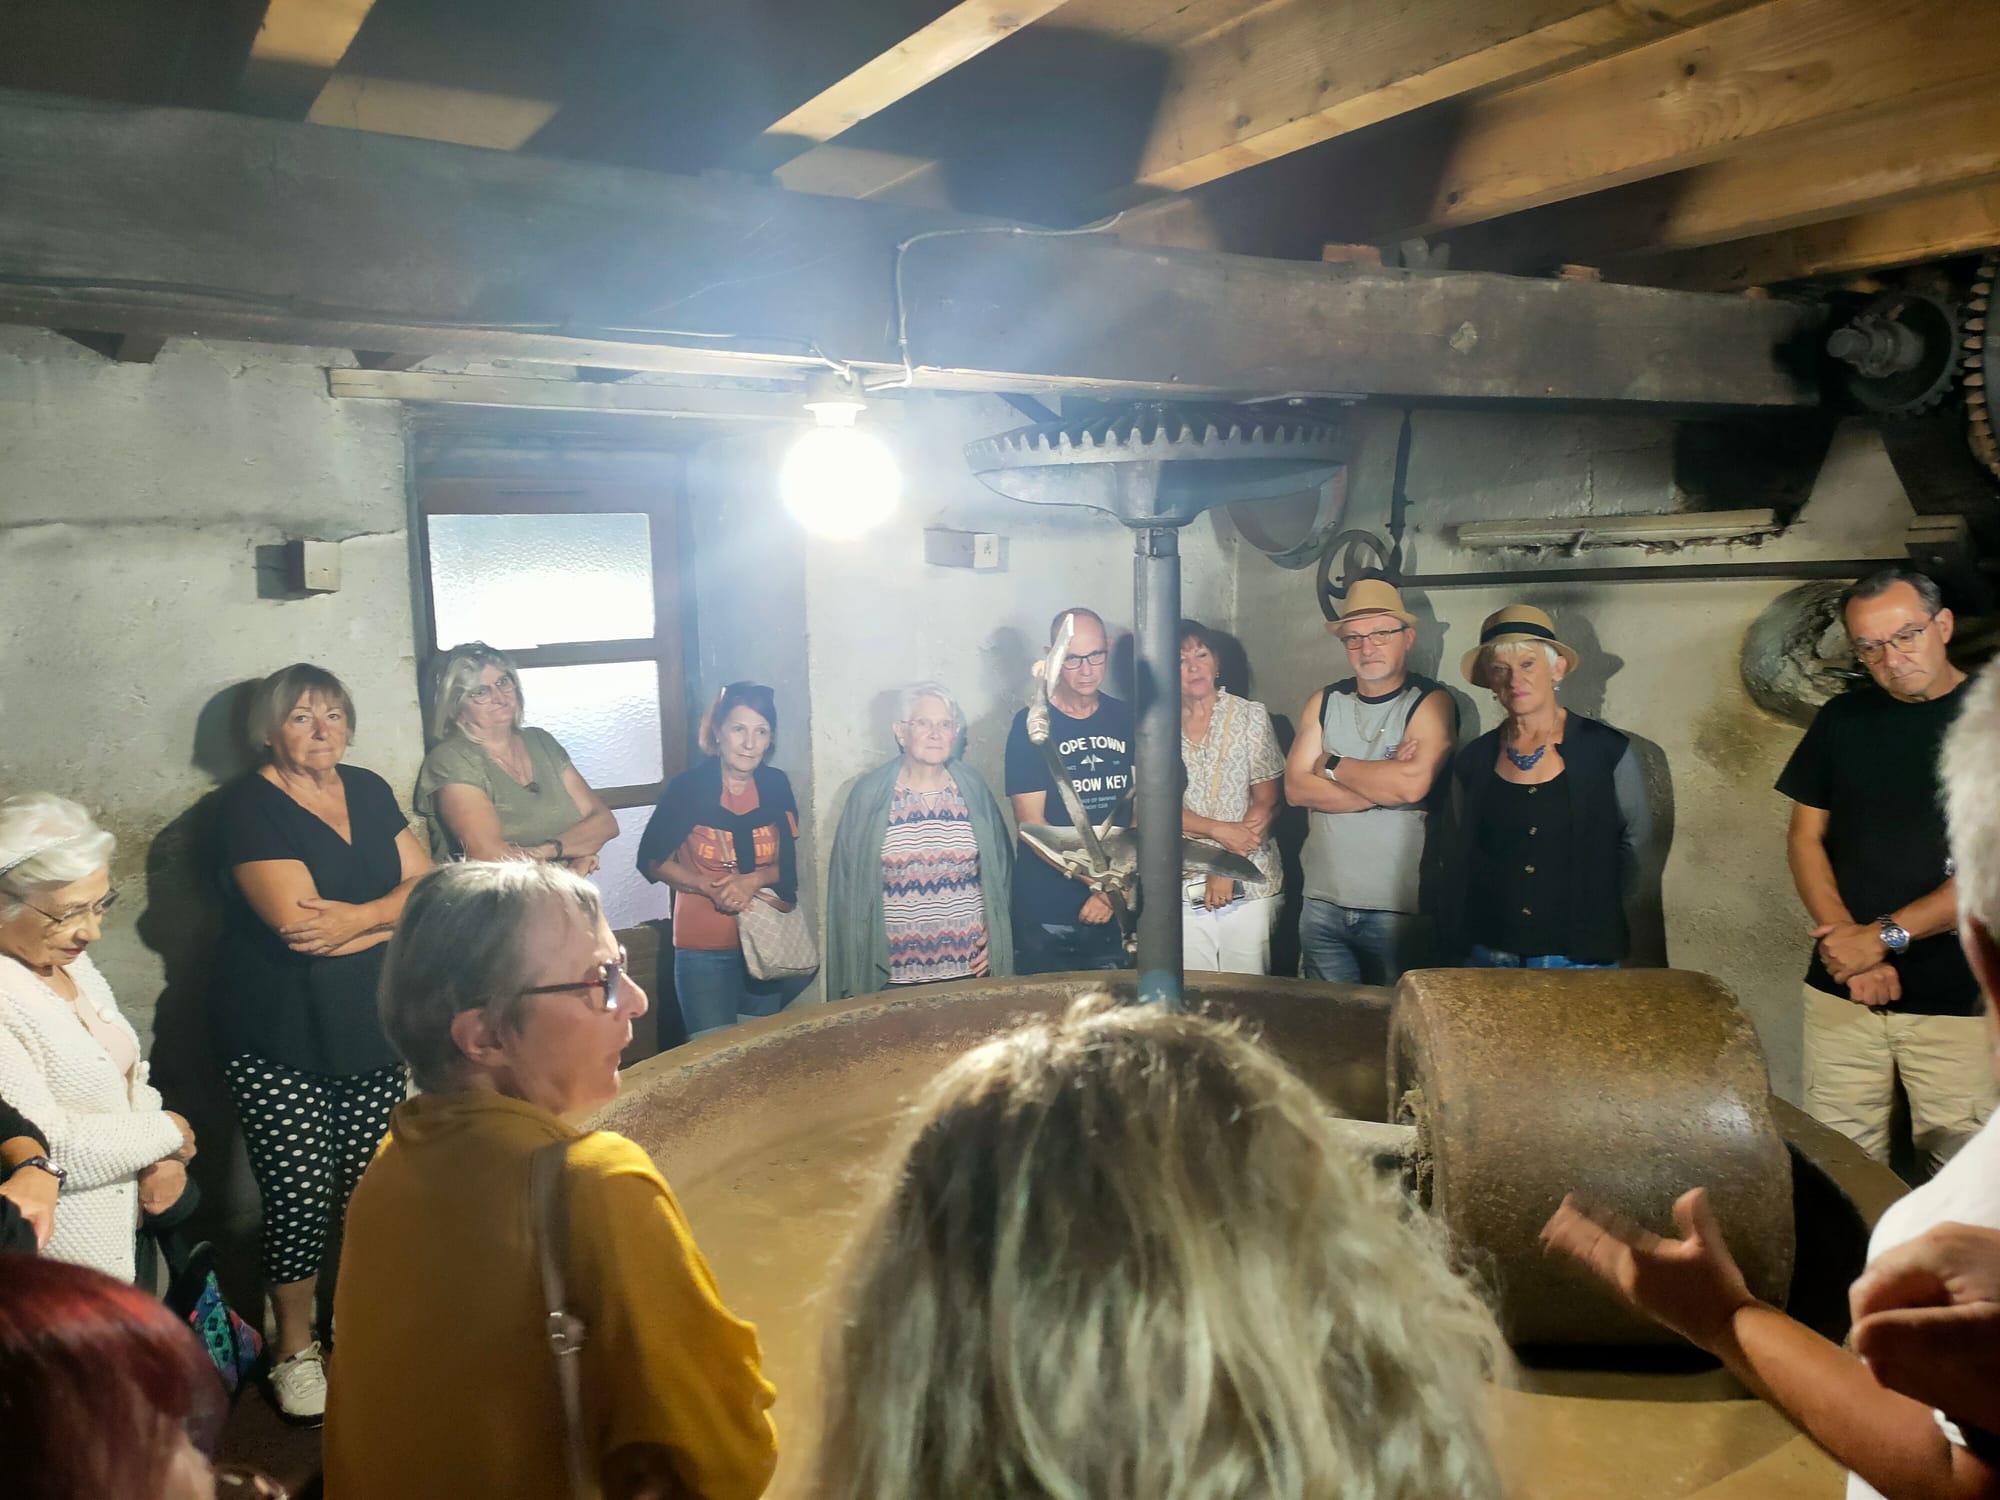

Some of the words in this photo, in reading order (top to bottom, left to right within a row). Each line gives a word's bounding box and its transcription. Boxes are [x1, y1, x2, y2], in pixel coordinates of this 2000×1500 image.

[1059, 737, 1088, 755] OPE
[1088, 735, 1126, 754] TOWN
[1072, 777, 1102, 793] BOW
[1106, 775, 1128, 790] KEY
